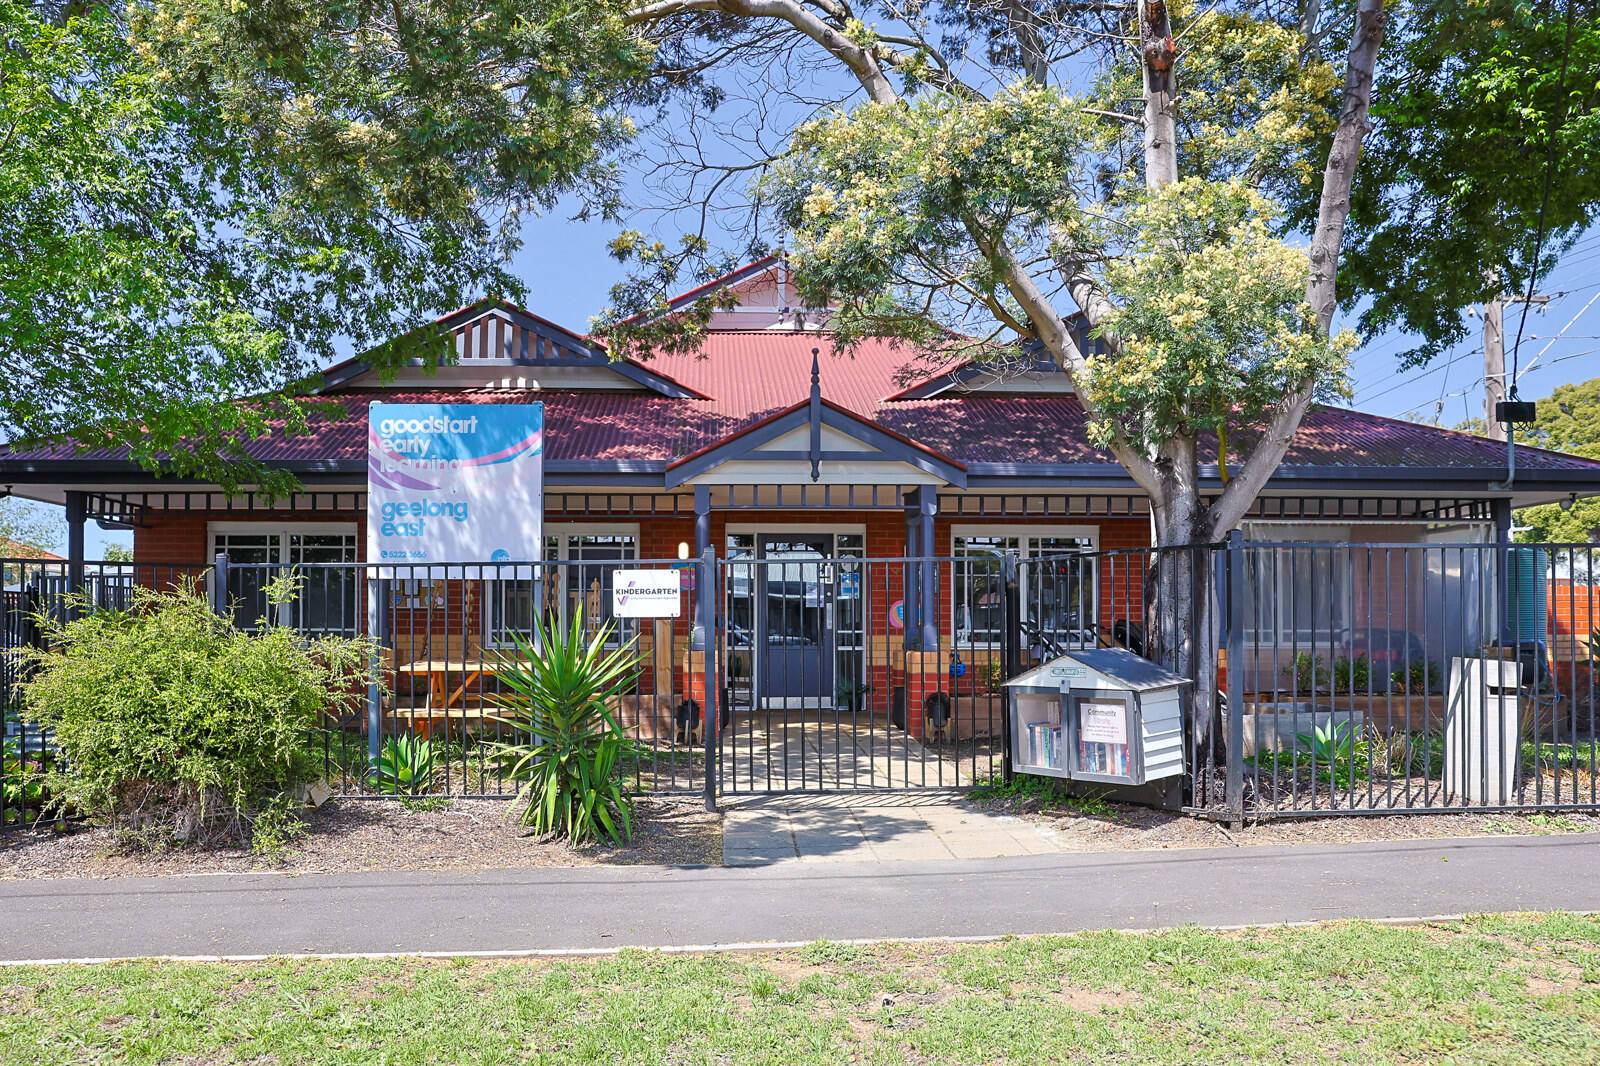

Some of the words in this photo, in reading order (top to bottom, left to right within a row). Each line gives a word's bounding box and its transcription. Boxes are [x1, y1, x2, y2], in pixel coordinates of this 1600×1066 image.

[380, 416, 478, 438] goodstart
[380, 436, 431, 457] early
[381, 499, 469, 522] geelong
[381, 519, 425, 537] east
